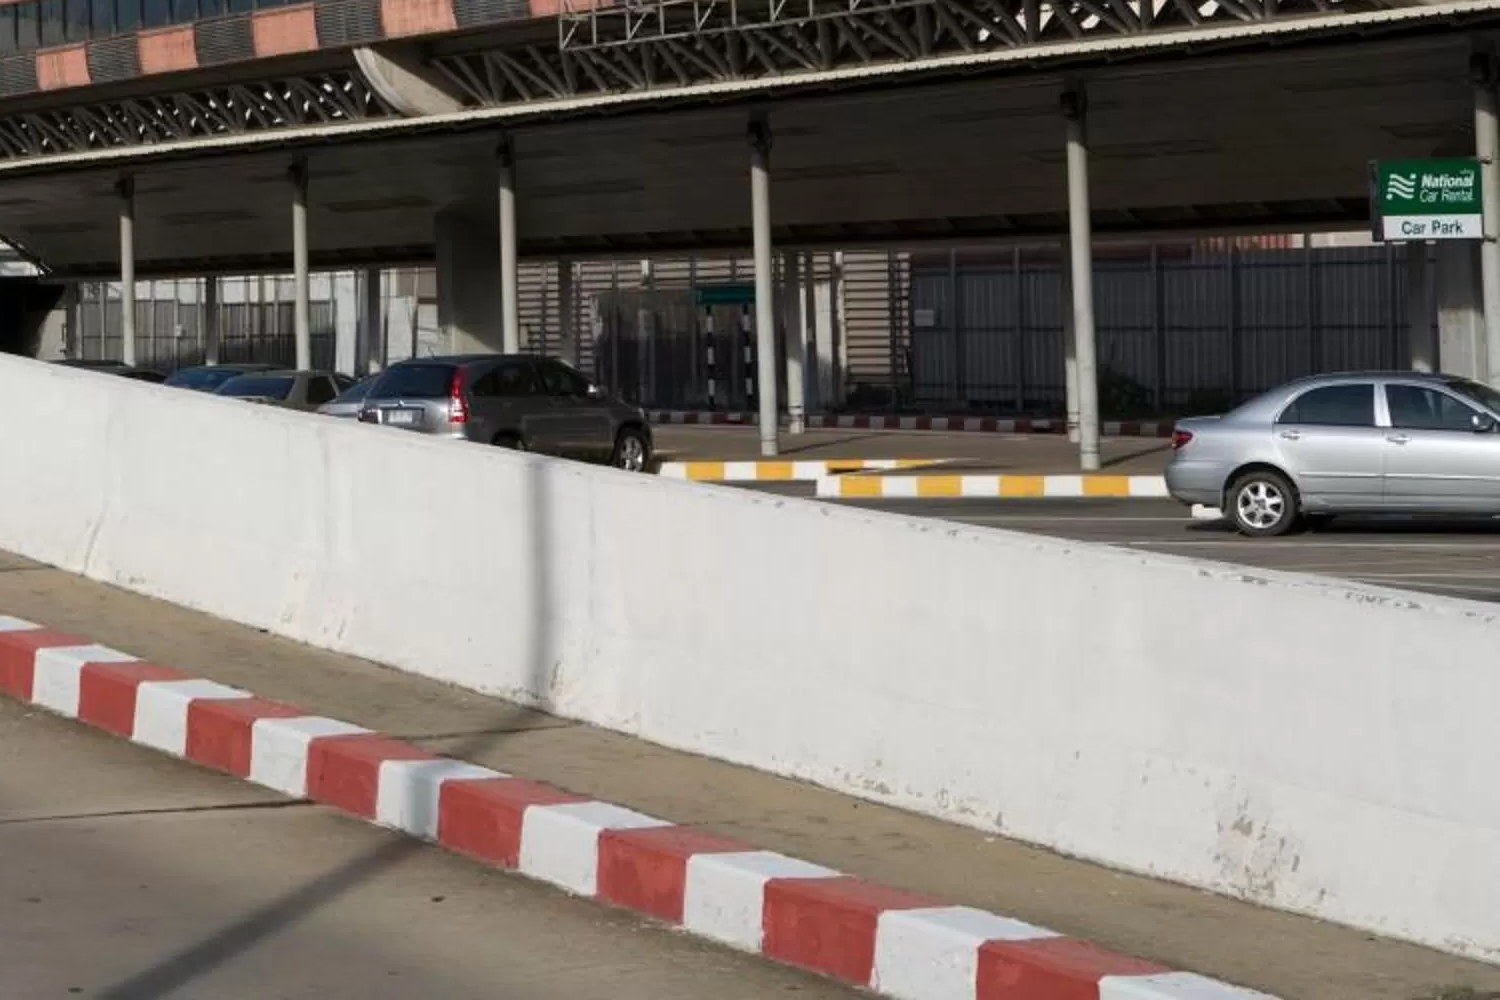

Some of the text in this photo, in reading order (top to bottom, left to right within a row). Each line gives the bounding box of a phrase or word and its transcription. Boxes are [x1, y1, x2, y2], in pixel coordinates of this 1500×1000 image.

[1421, 171, 1474, 188] National
[1419, 188, 1473, 203] Car Rental
[1401, 219, 1464, 235] Car Park
